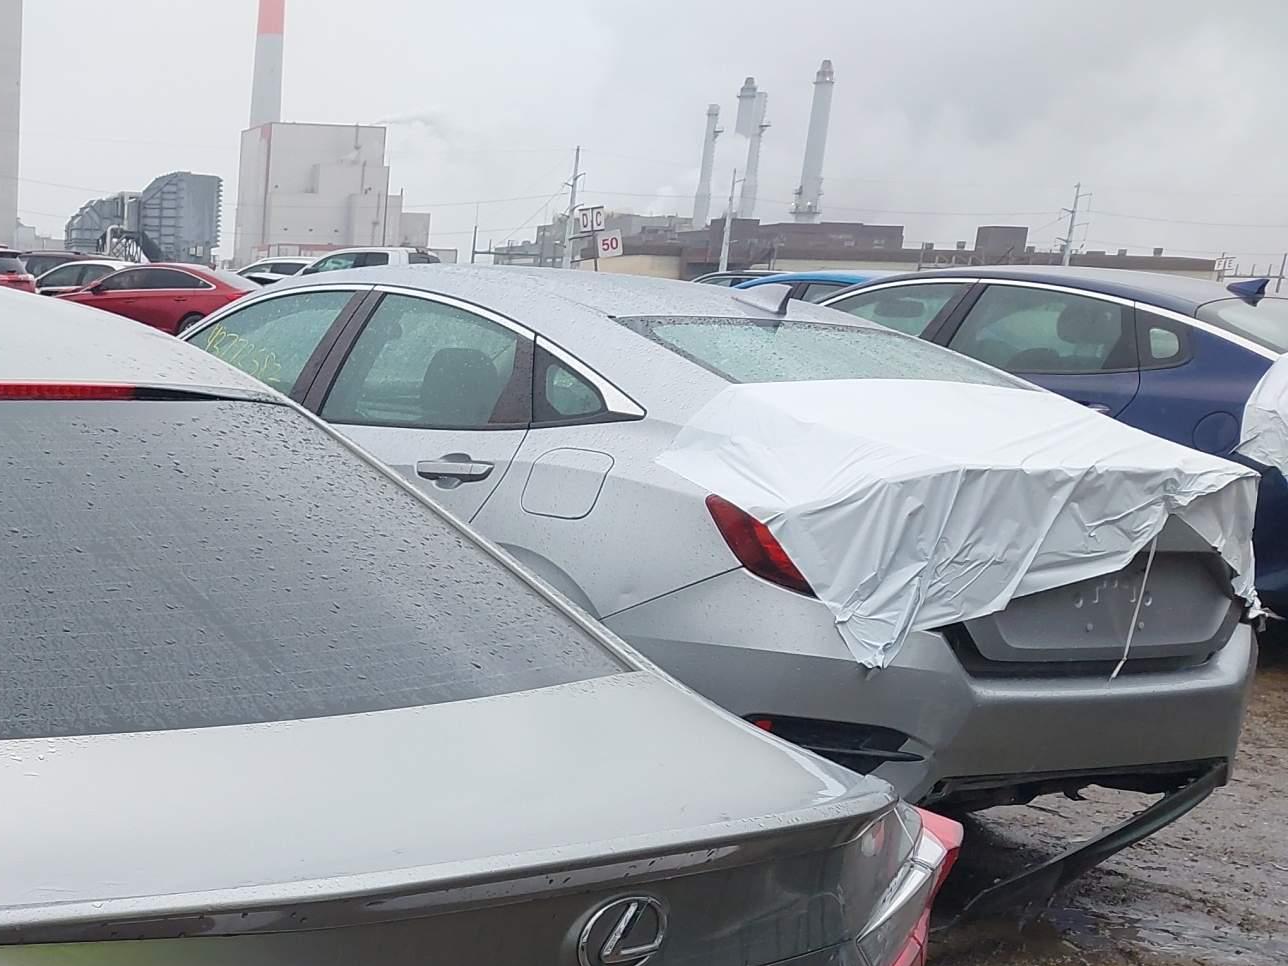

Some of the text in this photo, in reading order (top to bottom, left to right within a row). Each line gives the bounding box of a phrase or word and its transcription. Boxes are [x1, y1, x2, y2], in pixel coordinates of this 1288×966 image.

[581, 211, 603, 228] D C
[601, 237, 619, 251] 50
